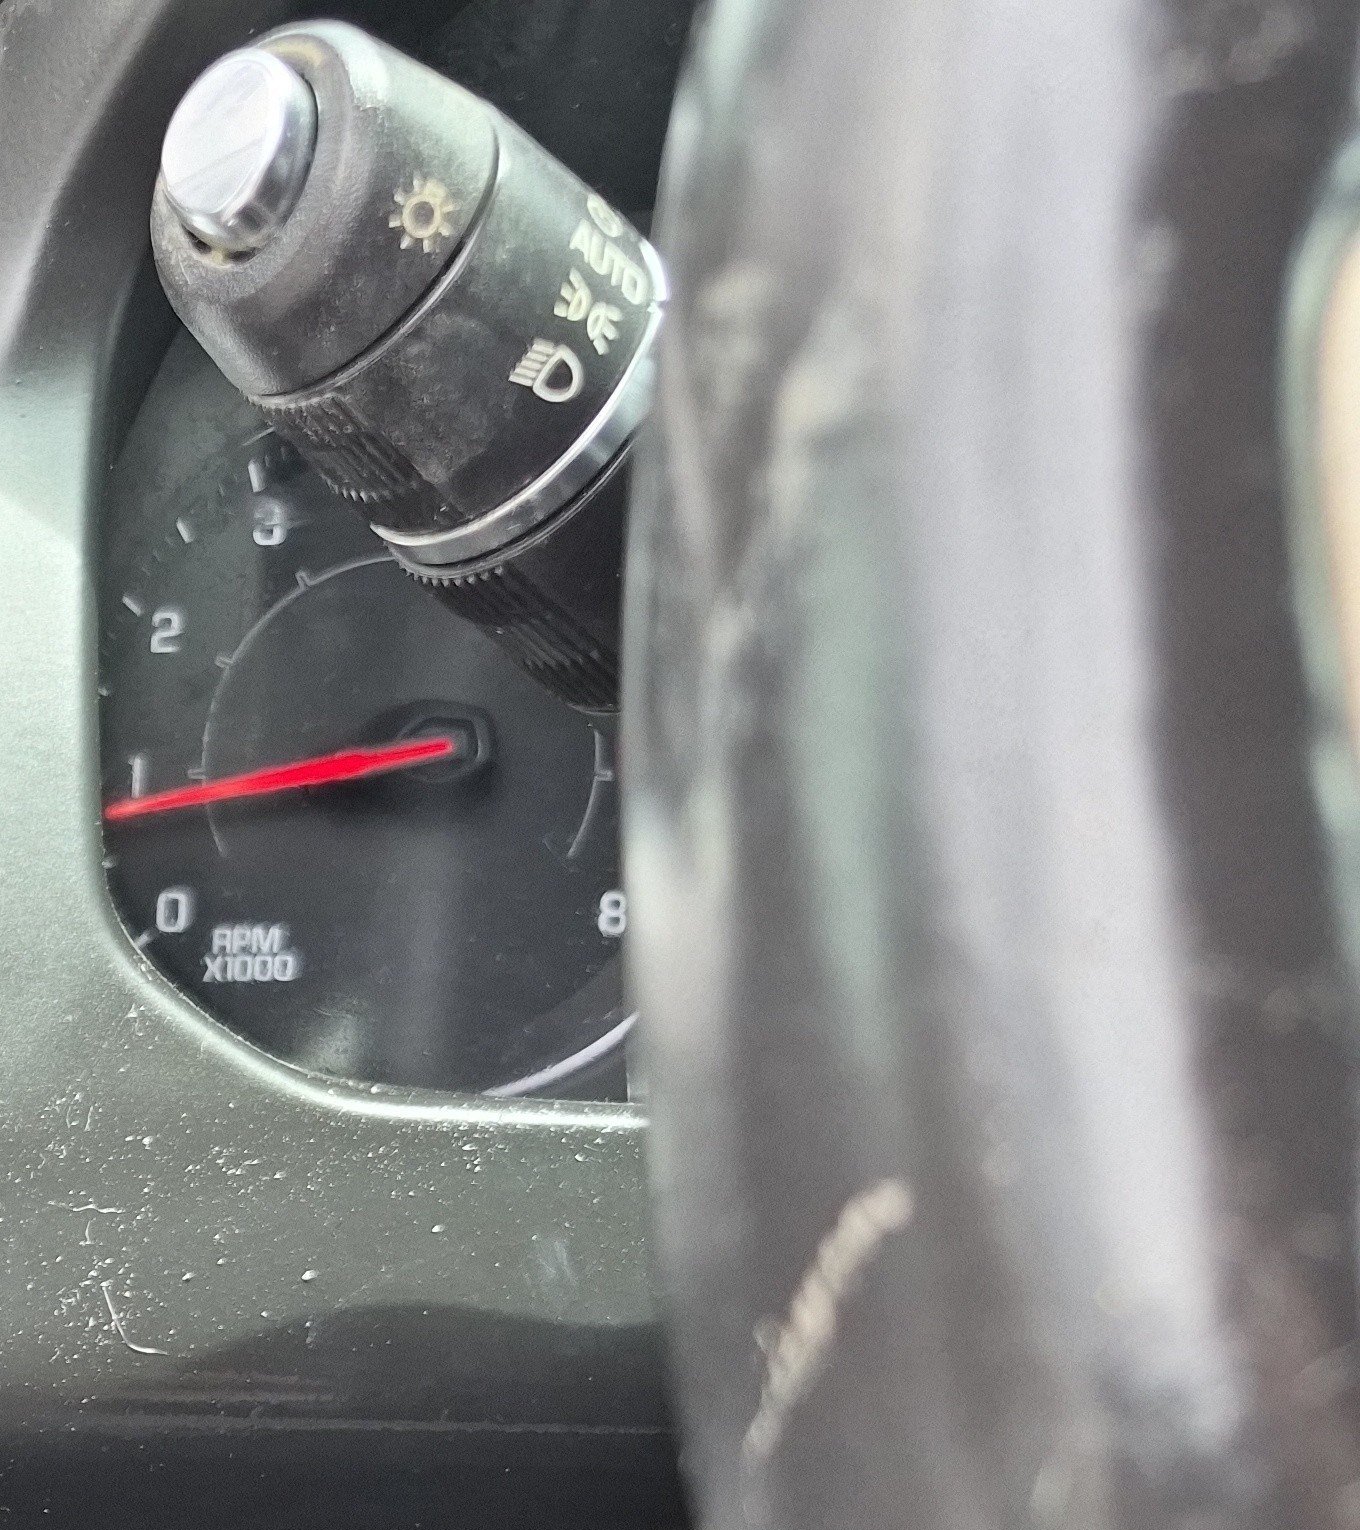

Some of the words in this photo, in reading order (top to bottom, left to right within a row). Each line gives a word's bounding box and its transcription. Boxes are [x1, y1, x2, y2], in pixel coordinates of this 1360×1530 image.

[568, 218, 648, 305] AUTO
[253, 501, 287, 546] 3
[150, 611, 184, 654] 2
[129, 756, 146, 799] 1
[156, 890, 191, 933] 0
[598, 891, 627, 937] 8
[211, 926, 283, 955] RPM
[203, 954, 297, 982] X1000
